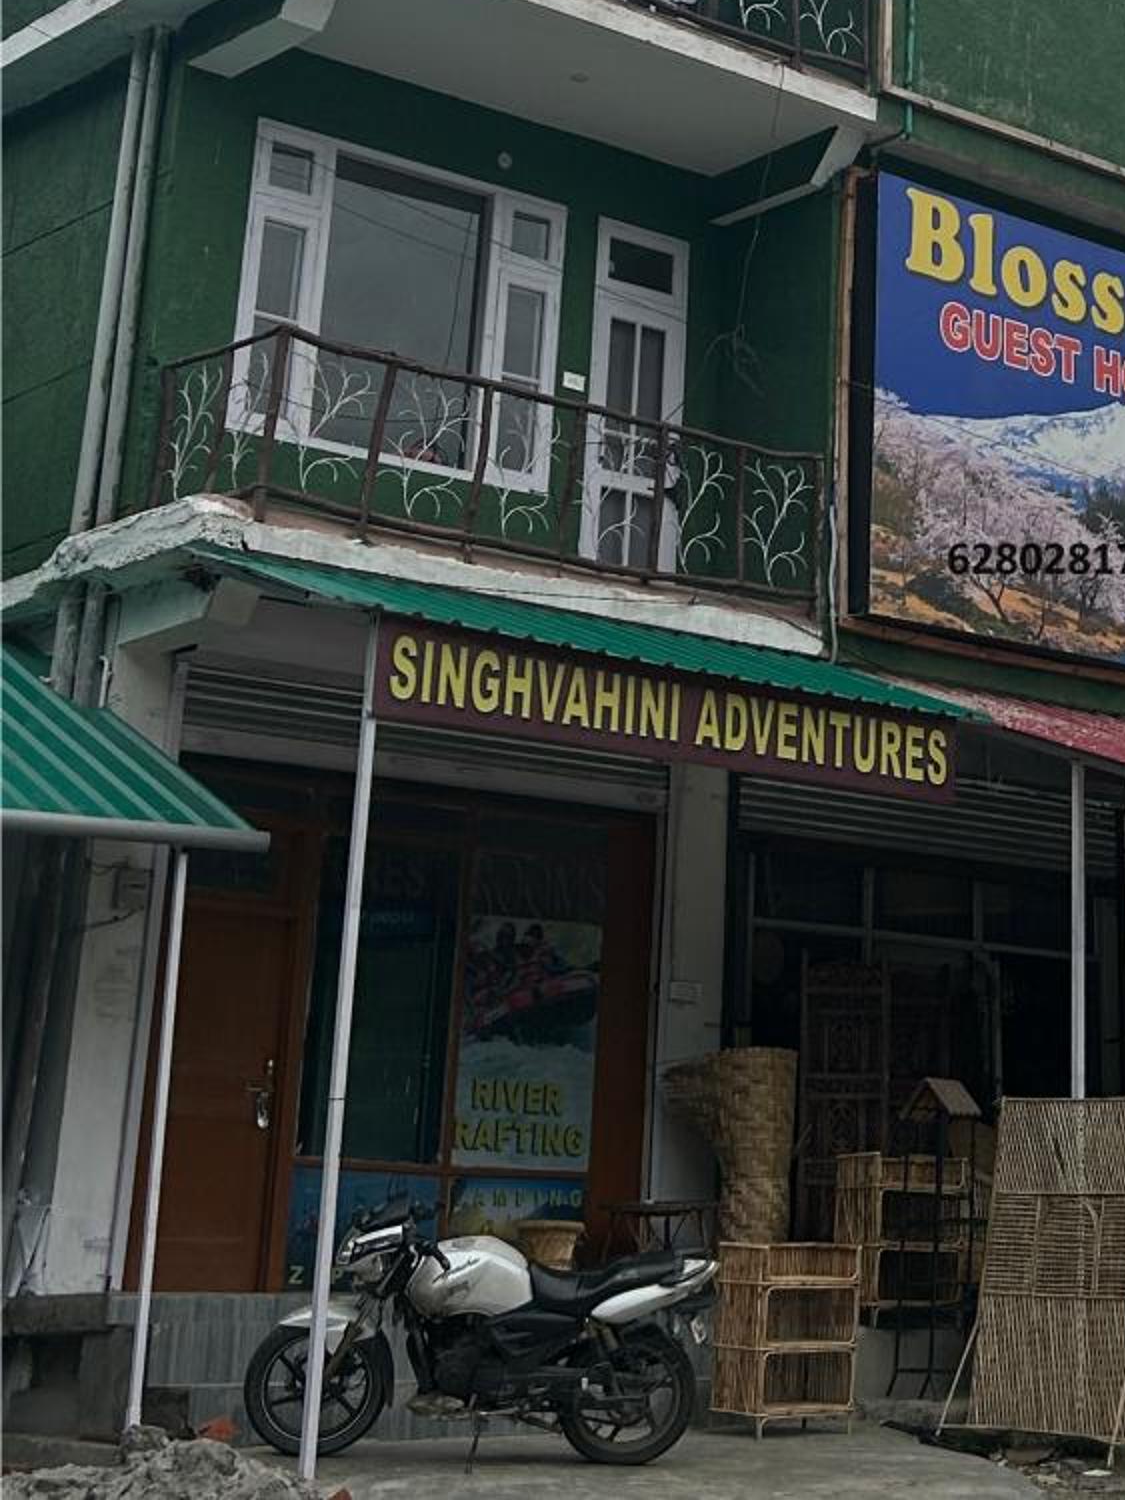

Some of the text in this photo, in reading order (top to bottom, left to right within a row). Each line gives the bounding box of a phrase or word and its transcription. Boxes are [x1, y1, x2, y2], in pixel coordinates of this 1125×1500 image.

[940, 301, 1082, 382] GUEST
[389, 634, 948, 786] SINGHVAHINI ADVENTURES
[472, 1077, 562, 1116] RIVER
[454, 1117, 584, 1157] RAFTING
